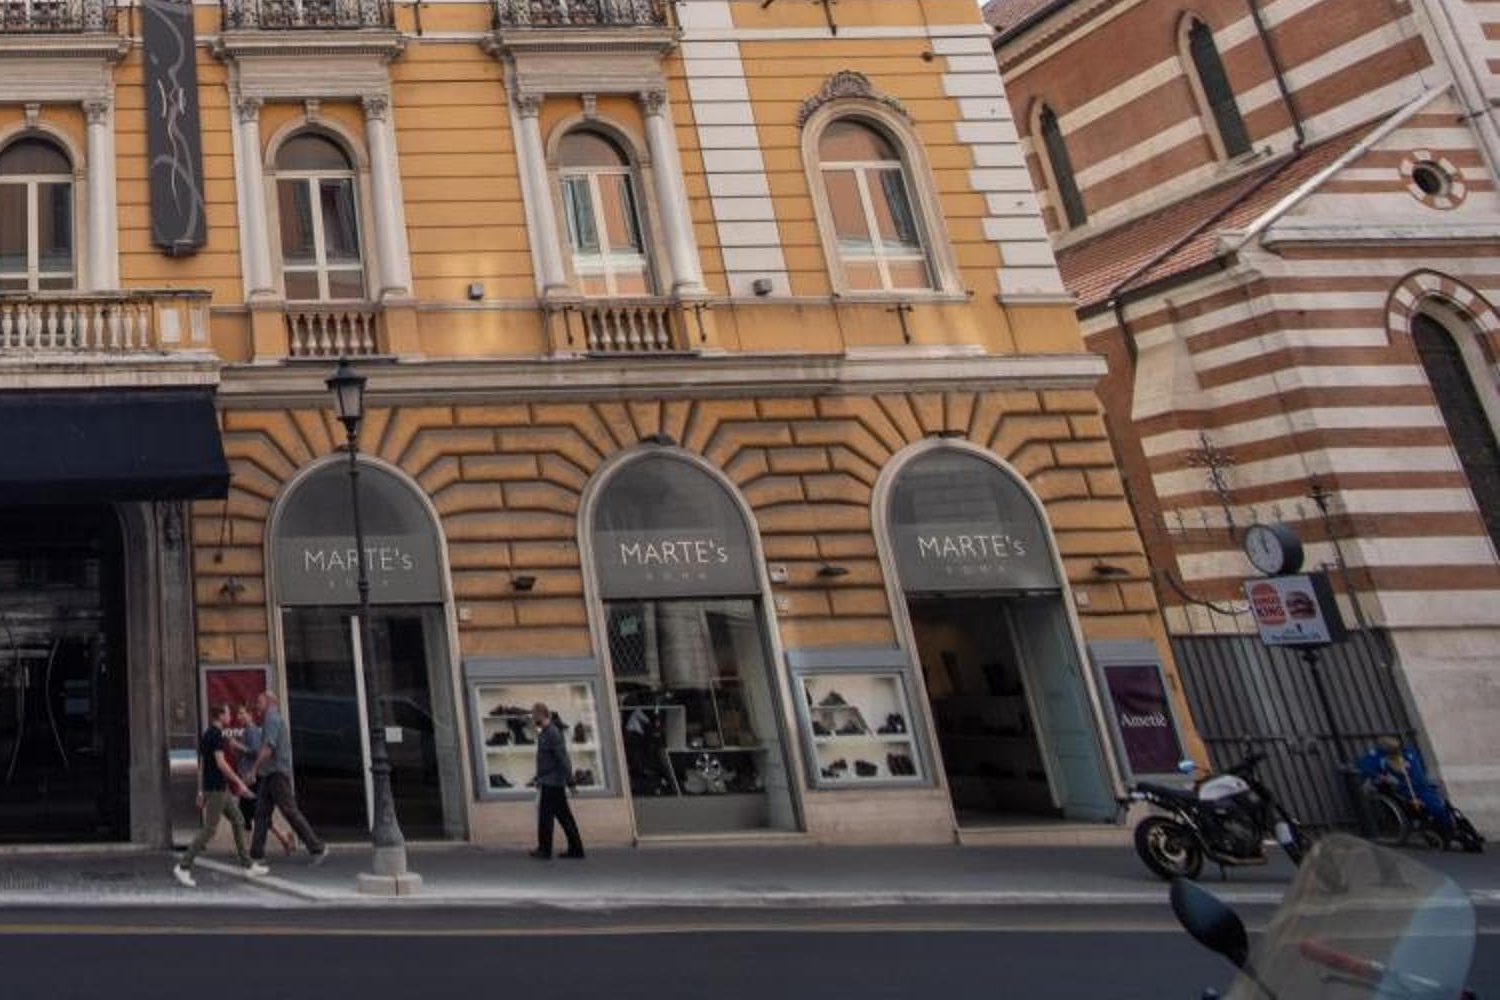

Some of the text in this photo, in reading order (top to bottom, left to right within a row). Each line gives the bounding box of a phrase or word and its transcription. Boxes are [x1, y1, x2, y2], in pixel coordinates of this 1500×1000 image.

[620, 539, 729, 566] MARTE's
[917, 536, 1028, 558] MARTE's
[1256, 605, 1285, 618] KING
